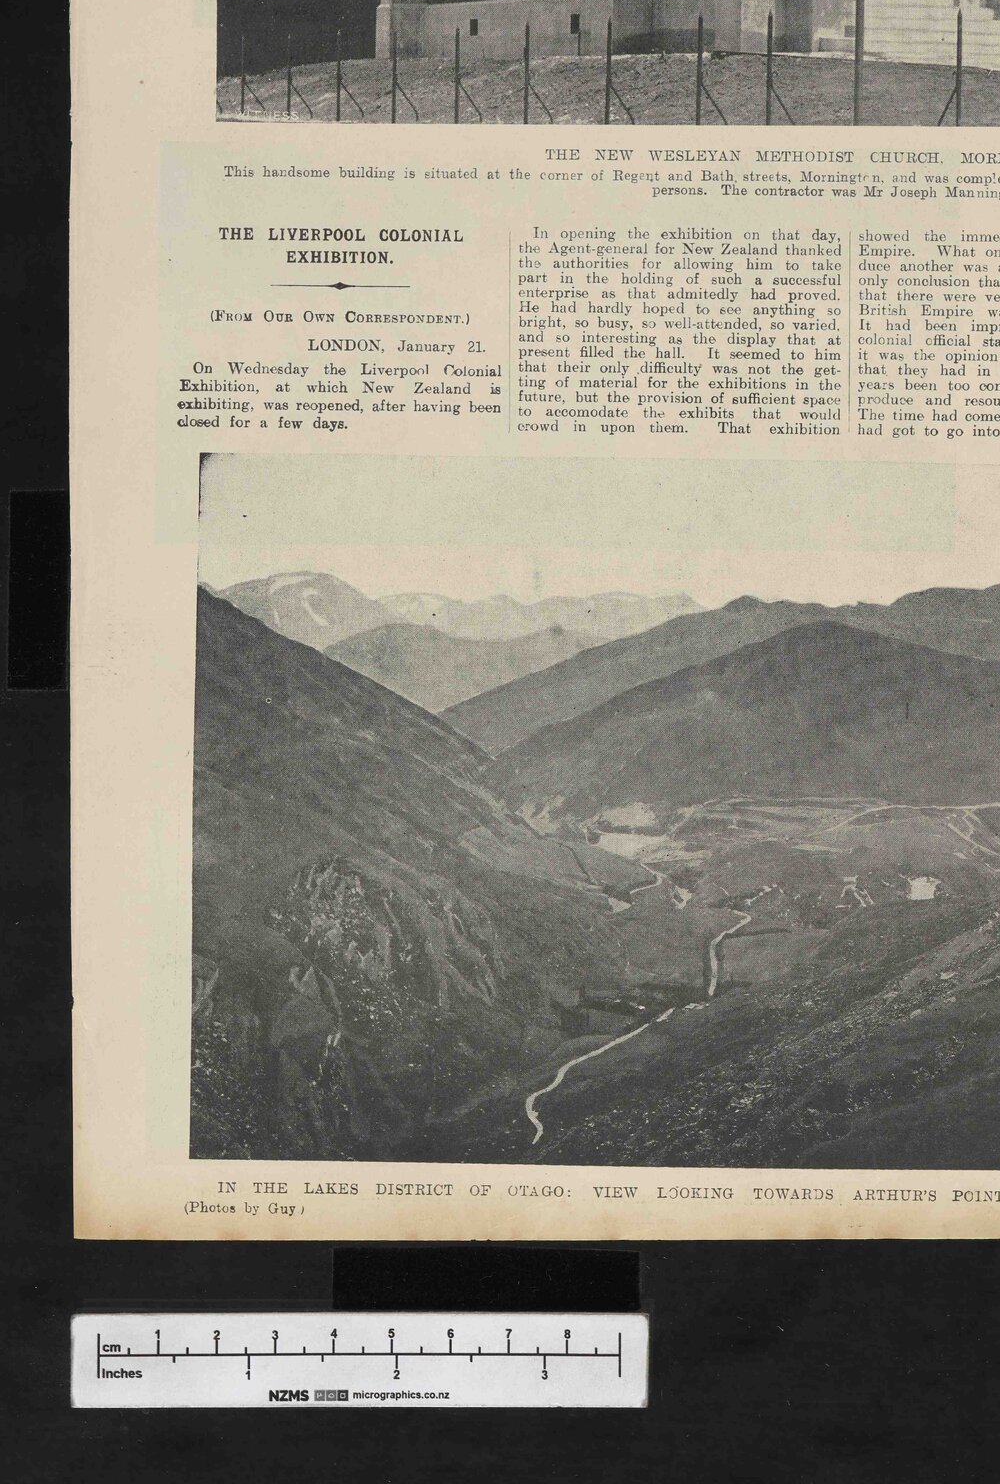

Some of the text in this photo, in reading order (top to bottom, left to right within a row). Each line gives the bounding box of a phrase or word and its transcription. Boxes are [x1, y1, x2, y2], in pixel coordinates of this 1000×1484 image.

[544, 148, 581, 161] THE
[594, 148, 635, 162] NEW
[647, 149, 742, 162] WESLEYAN
[755, 150, 855, 164] METHODIST
[651, 186, 708, 198] persons.
[720, 183, 748, 197] The
[754, 184, 825, 197] contractor
[830, 188, 858, 198] was
[862, 185, 884, 198] Mr
[890, 185, 938, 201] Joseph
[218, 226, 464, 243] THE LIVERPOOL COLONIAL
[532, 226, 841, 245] In opening the exhibition on that day,
[858, 228, 910, 242] showed
[923, 229, 947, 243] the
[285, 250, 394, 265] EXHIBITION.
[307, 338, 486, 356] LONDON, January 21.
[192, 360, 502, 379] On Wednesday the Liverpool Colonial
[178, 378, 502, 396] Exhibition, at which New Zealand is
[176, 396, 502, 416] exhibiting, was reopened, after having been
[857, 392, 914, 408] produce
[924, 392, 952, 407] and
[176, 413, 349, 433] closed for a few days.
[217, 1181, 237, 1194] IN
[252, 1181, 289, 1195] THE
[303, 1181, 359, 1196] LAKES
[375, 1182, 454, 1197] DISTRICT
[469, 1184, 492, 1197] OF
[507, 1184, 571, 1198] OTAGO:
[592, 1186, 639, 1199] VIEW
[656, 1185, 735, 1200] LOOKING
[752, 1187, 834, 1201] TOWARDS
[852, 1188, 937, 1204] ARTHUR'S
[183, 1200, 237, 1216] (Photos
[243, 1201, 260, 1217] by
[154, 1328, 571, 1340] 1 2 3 4 5 6 7 8
[102, 1343, 121, 1353] cm
[102, 1368, 549, 1380] Inches 1 2 3
[269, 1389, 450, 1402] NZMS micrographics.co.nz
